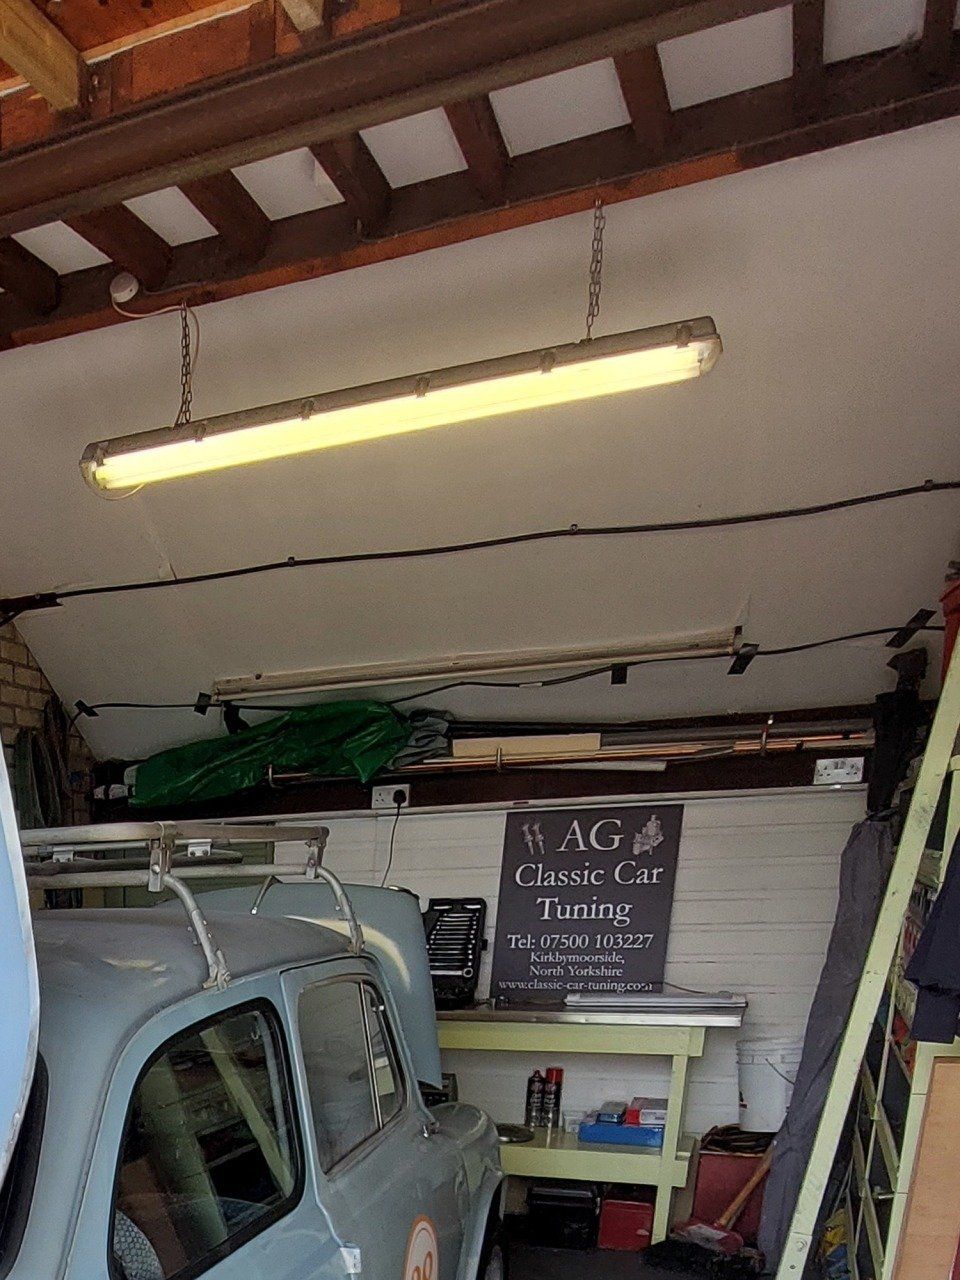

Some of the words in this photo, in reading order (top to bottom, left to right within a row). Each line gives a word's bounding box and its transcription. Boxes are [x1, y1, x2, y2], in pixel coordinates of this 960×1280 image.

[555, 819, 624, 852] AG
[515, 861, 606, 887] Classic
[614, 860, 664, 885] Car
[536, 896, 633, 927] Tuning
[507, 934, 536, 949] Tel:
[540, 934, 589, 949] 07500
[594, 934, 654, 949] 103227
[530, 952, 625, 965] Kirkbymoorside,
[529, 965, 564, 976] North
[568, 965, 623, 977] Yorkshire
